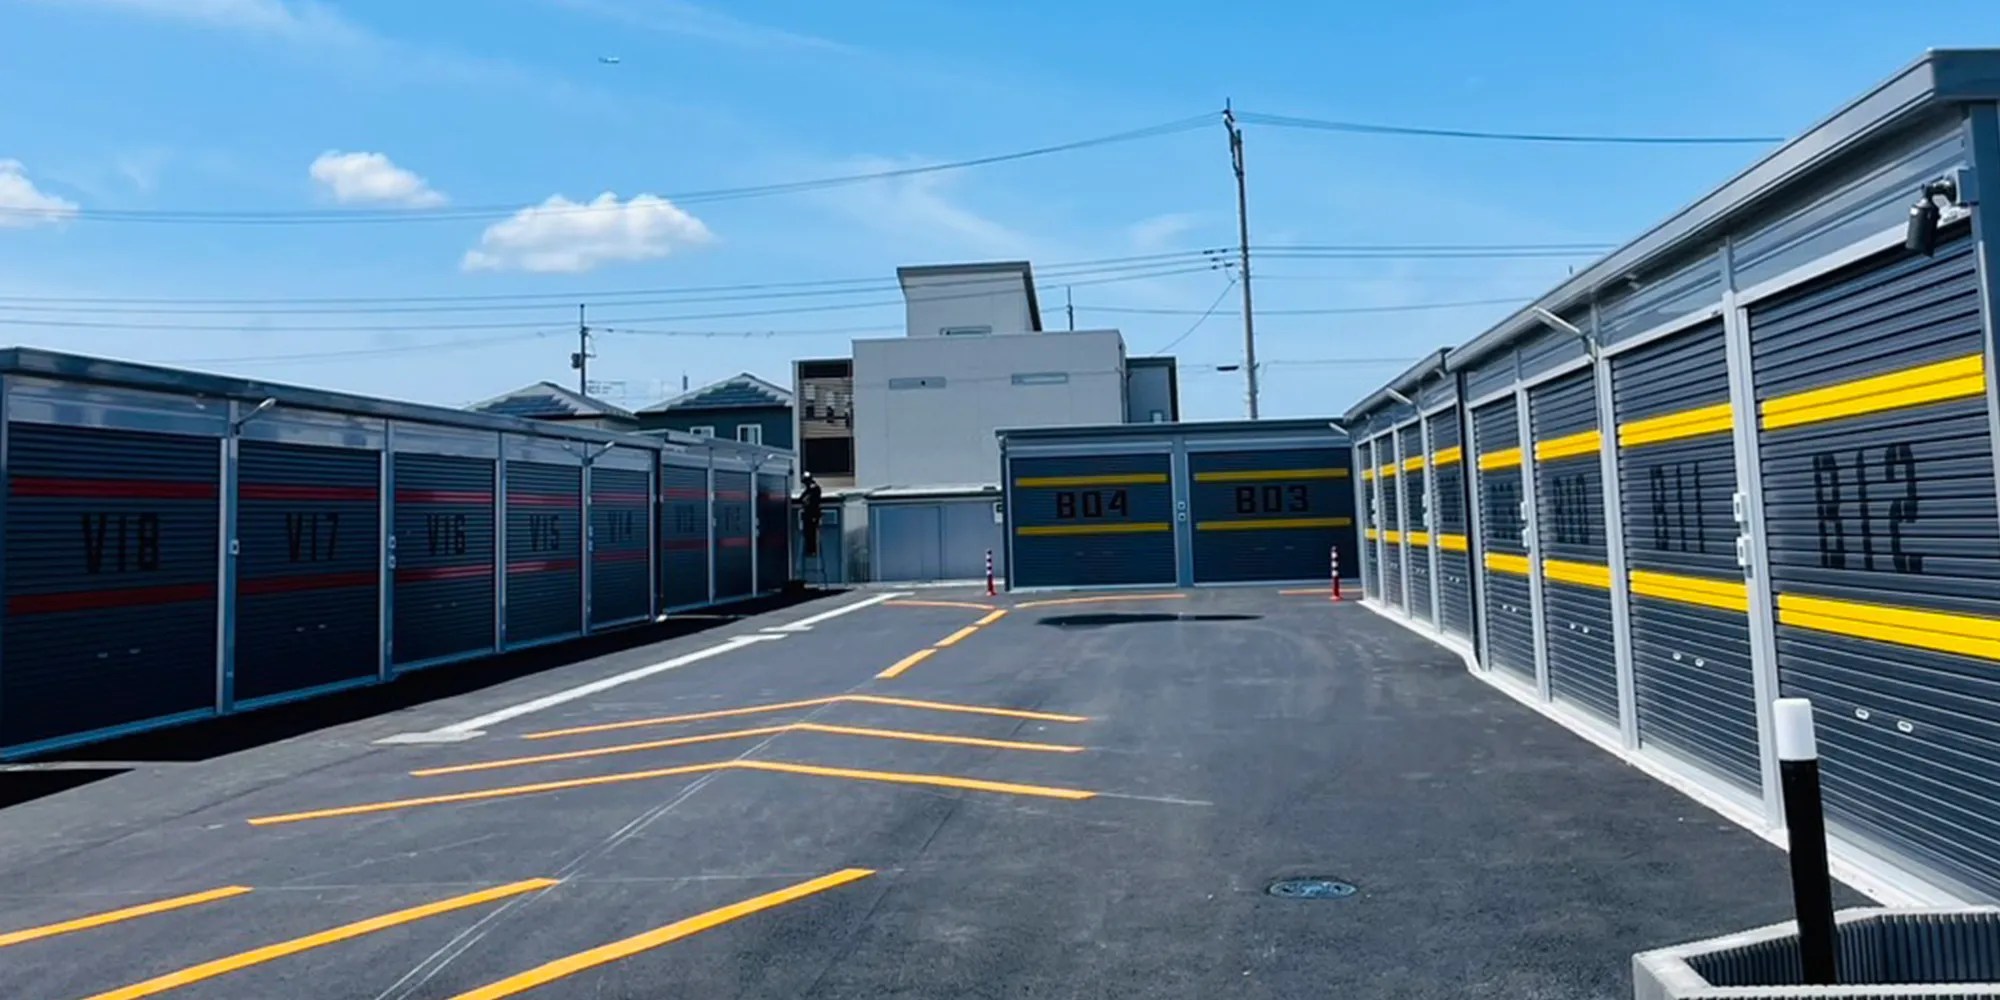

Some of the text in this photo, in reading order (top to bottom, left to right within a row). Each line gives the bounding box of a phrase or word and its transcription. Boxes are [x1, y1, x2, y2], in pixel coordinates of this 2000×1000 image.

[1056, 490, 1127, 518] B04
[1236, 484, 1309, 513] B03
[1812, 442, 1922, 573] B12
[82, 513, 159, 574] V18
[286, 512, 338, 562] V17
[426, 513, 465, 555] V16
